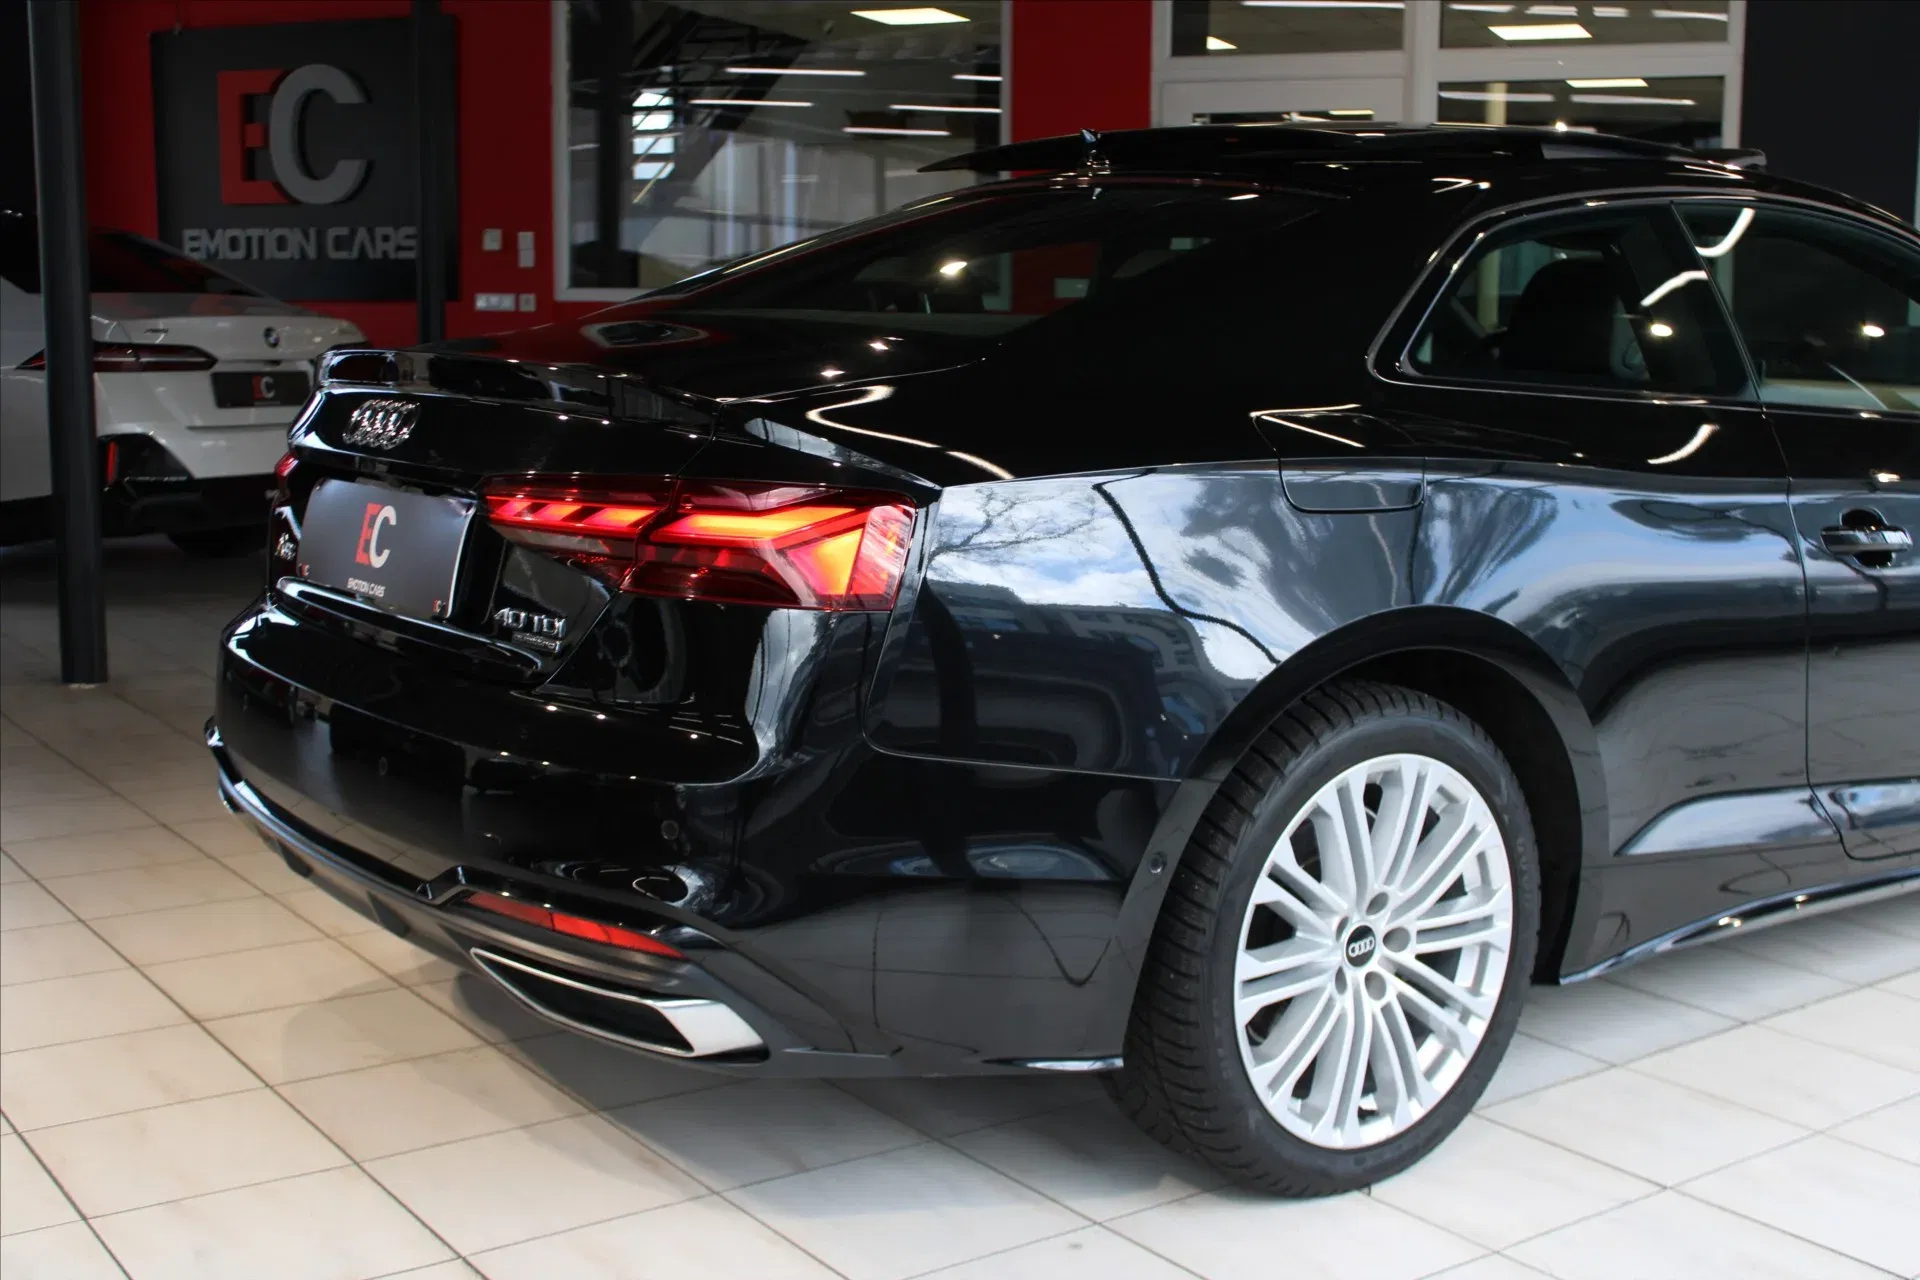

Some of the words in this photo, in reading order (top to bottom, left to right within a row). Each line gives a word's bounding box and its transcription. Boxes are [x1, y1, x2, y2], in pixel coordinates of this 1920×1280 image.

[217, 64, 368, 205] EC
[182, 227, 317, 260] EMOTION
[325, 225, 417, 260] CARS
[355, 503, 397, 568] EC
[494, 607, 526, 628] 40
[529, 613, 566, 637] TDI
